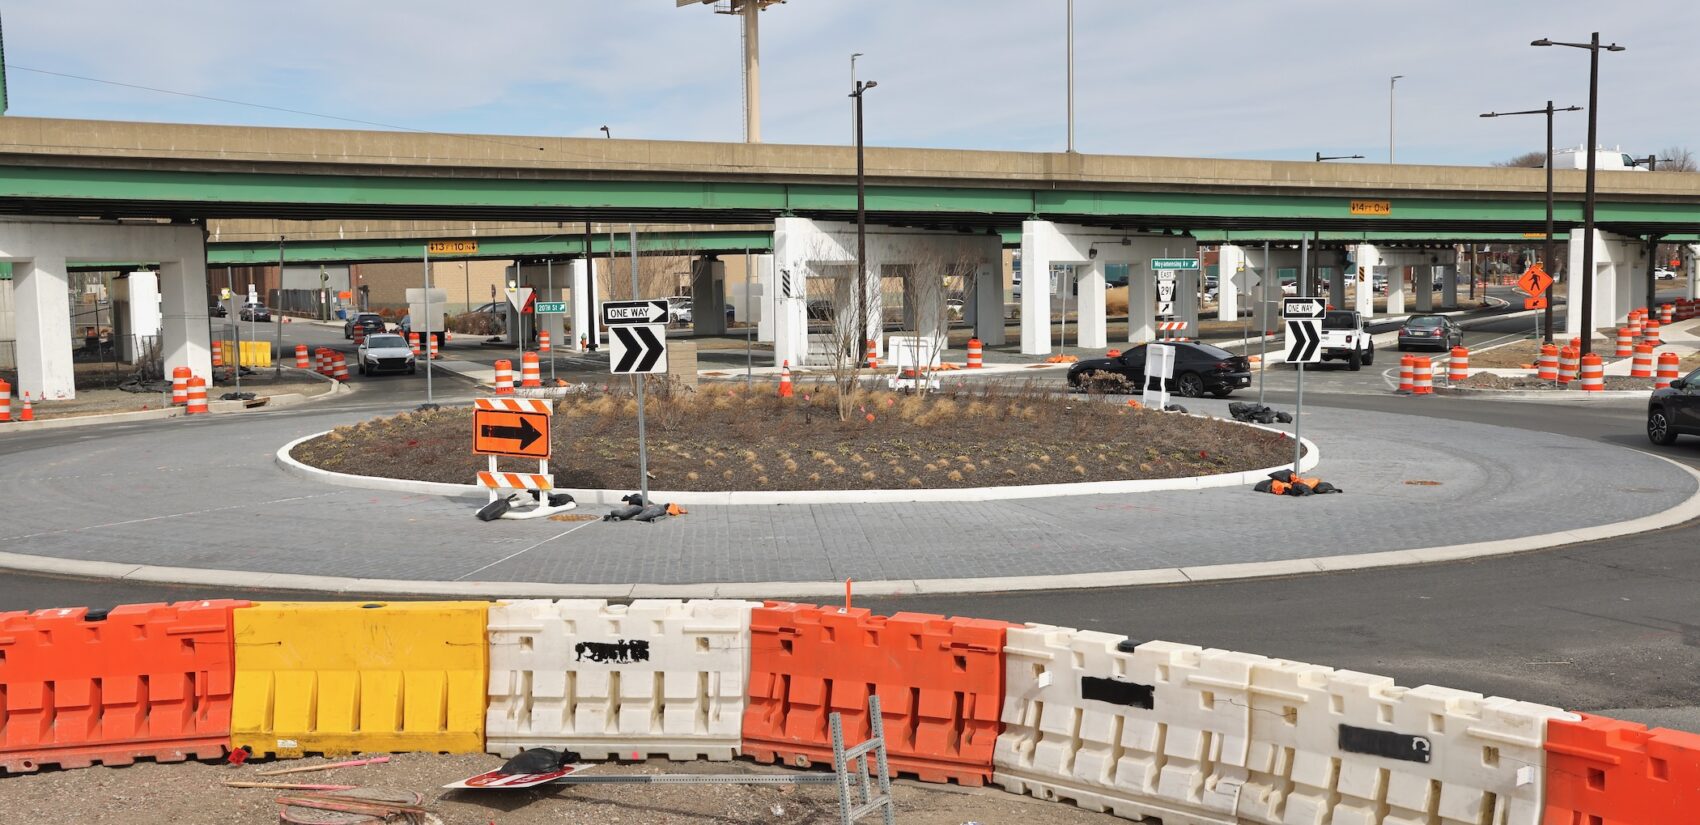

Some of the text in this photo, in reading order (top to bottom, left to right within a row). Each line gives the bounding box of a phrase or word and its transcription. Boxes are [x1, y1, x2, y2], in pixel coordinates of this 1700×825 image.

[1161, 286, 1171, 295] 291
[610, 308, 649, 318] ONE WAY
